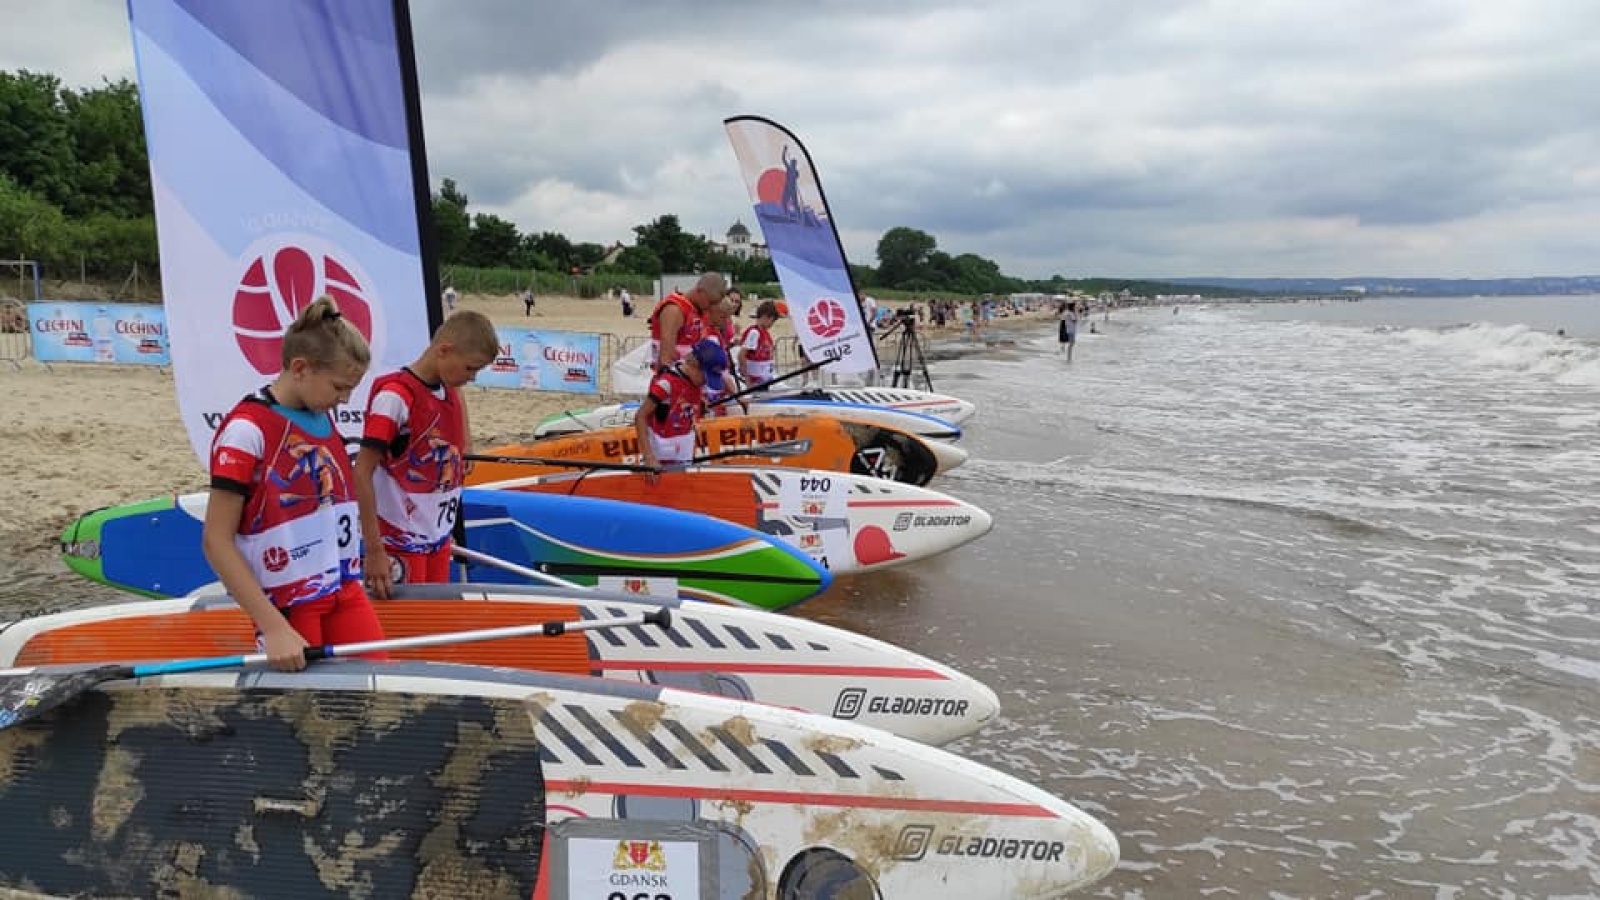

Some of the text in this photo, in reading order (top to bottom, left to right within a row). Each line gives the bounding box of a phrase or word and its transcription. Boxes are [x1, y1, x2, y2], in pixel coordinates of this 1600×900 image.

[800, 476, 831, 492] 044
[437, 496, 458, 528] 78
[337, 514, 352, 548] 3
[868, 696, 969, 717] GLADIATOR
[937, 836, 1065, 862] GLADIATOR
